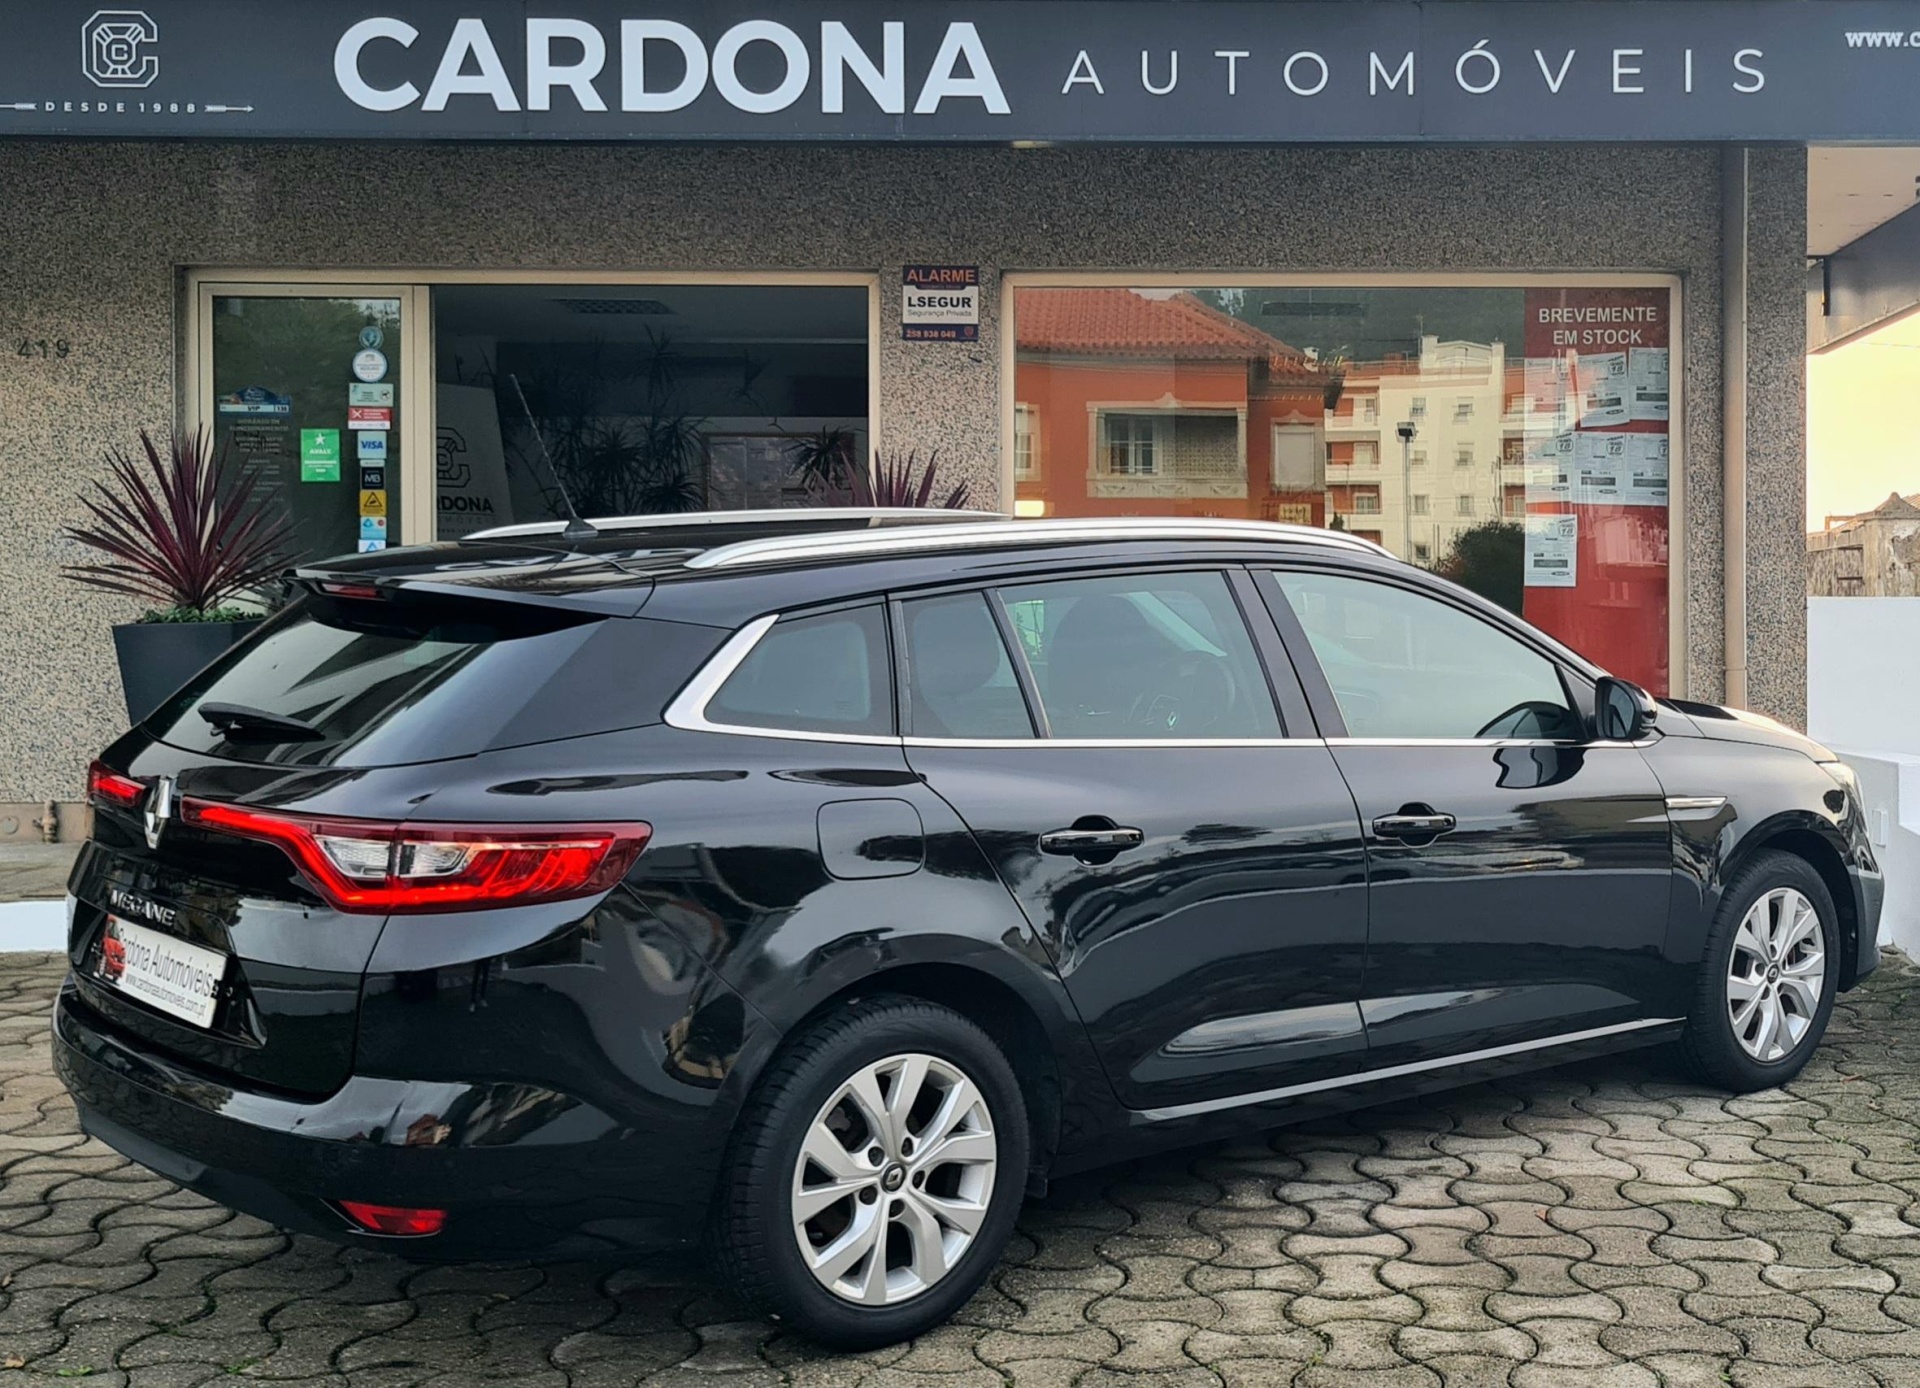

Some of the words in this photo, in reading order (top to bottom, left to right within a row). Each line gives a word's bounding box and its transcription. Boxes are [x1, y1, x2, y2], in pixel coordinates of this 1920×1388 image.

[333, 17, 1010, 116] CARDONA
[1061, 39, 1766, 97] AUTOMÓVEIS
[45, 101, 125, 113] DESDE
[139, 102, 196, 114] 1988
[907, 269, 975, 283] ALARME
[907, 296, 972, 308] LSEGUR
[907, 309, 944, 318] Segurança
[946, 309, 972, 318] Privada
[1538, 306, 1658, 323] BREVEMENTE
[1552, 329, 1578, 346] EM
[1581, 328, 1643, 345] STOCK
[17, 337, 71, 360] 419
[360, 440, 384, 450] VISA
[364, 473, 382, 483] MB
[110, 889, 176, 927] MEGANE
[151, 944, 214, 997] Automóveis
